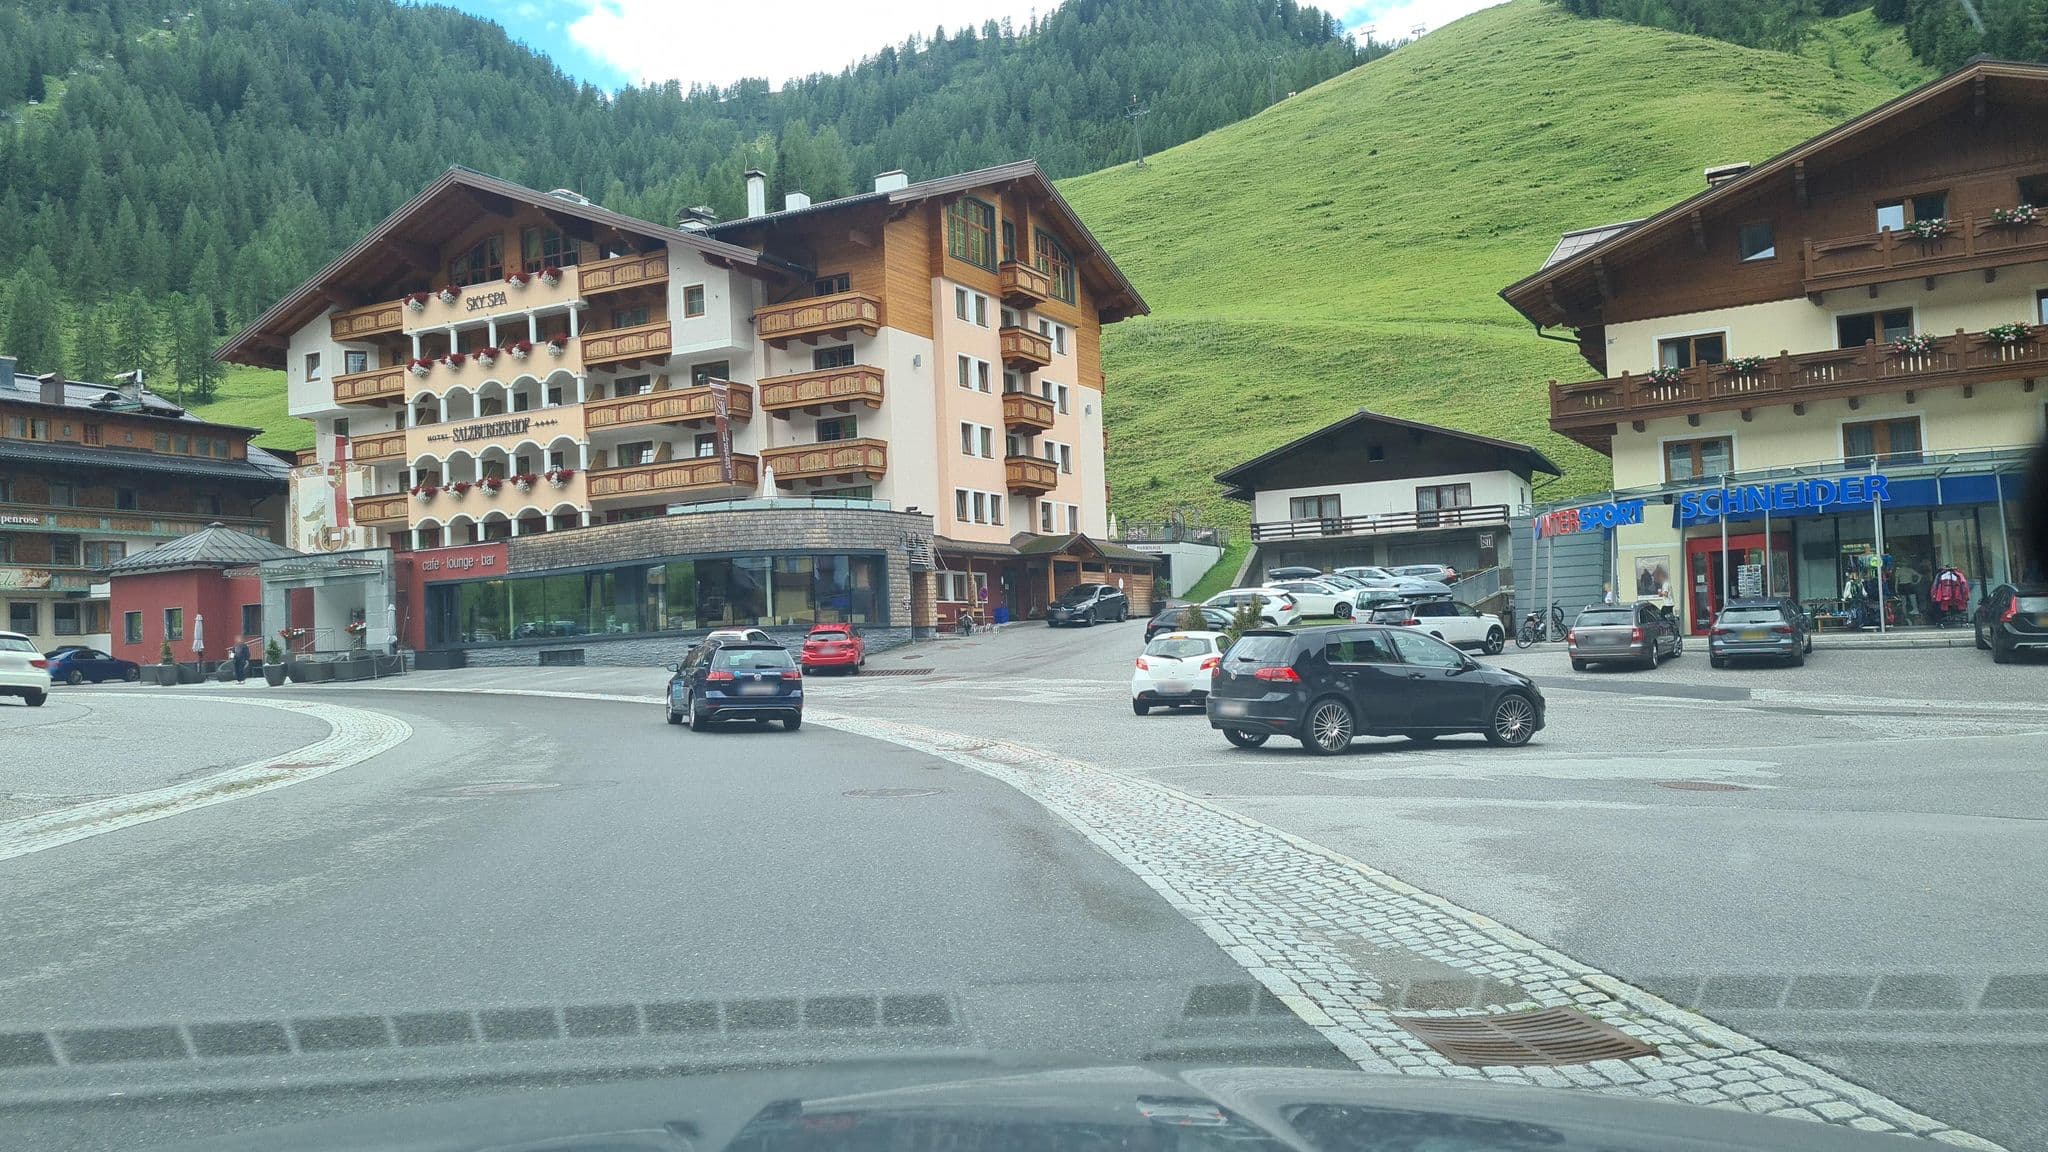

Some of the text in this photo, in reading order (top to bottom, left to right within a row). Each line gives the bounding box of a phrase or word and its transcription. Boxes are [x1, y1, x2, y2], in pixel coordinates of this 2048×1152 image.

[466, 291, 507, 311] SKY SPA
[452, 417, 531, 443] SALZBURGERHOF
[1680, 474, 1891, 519] SCHNEIDER
[1533, 500, 1647, 539] INTERSPORT
[446, 556, 474, 570] lounge
[481, 553, 495, 566] bar
